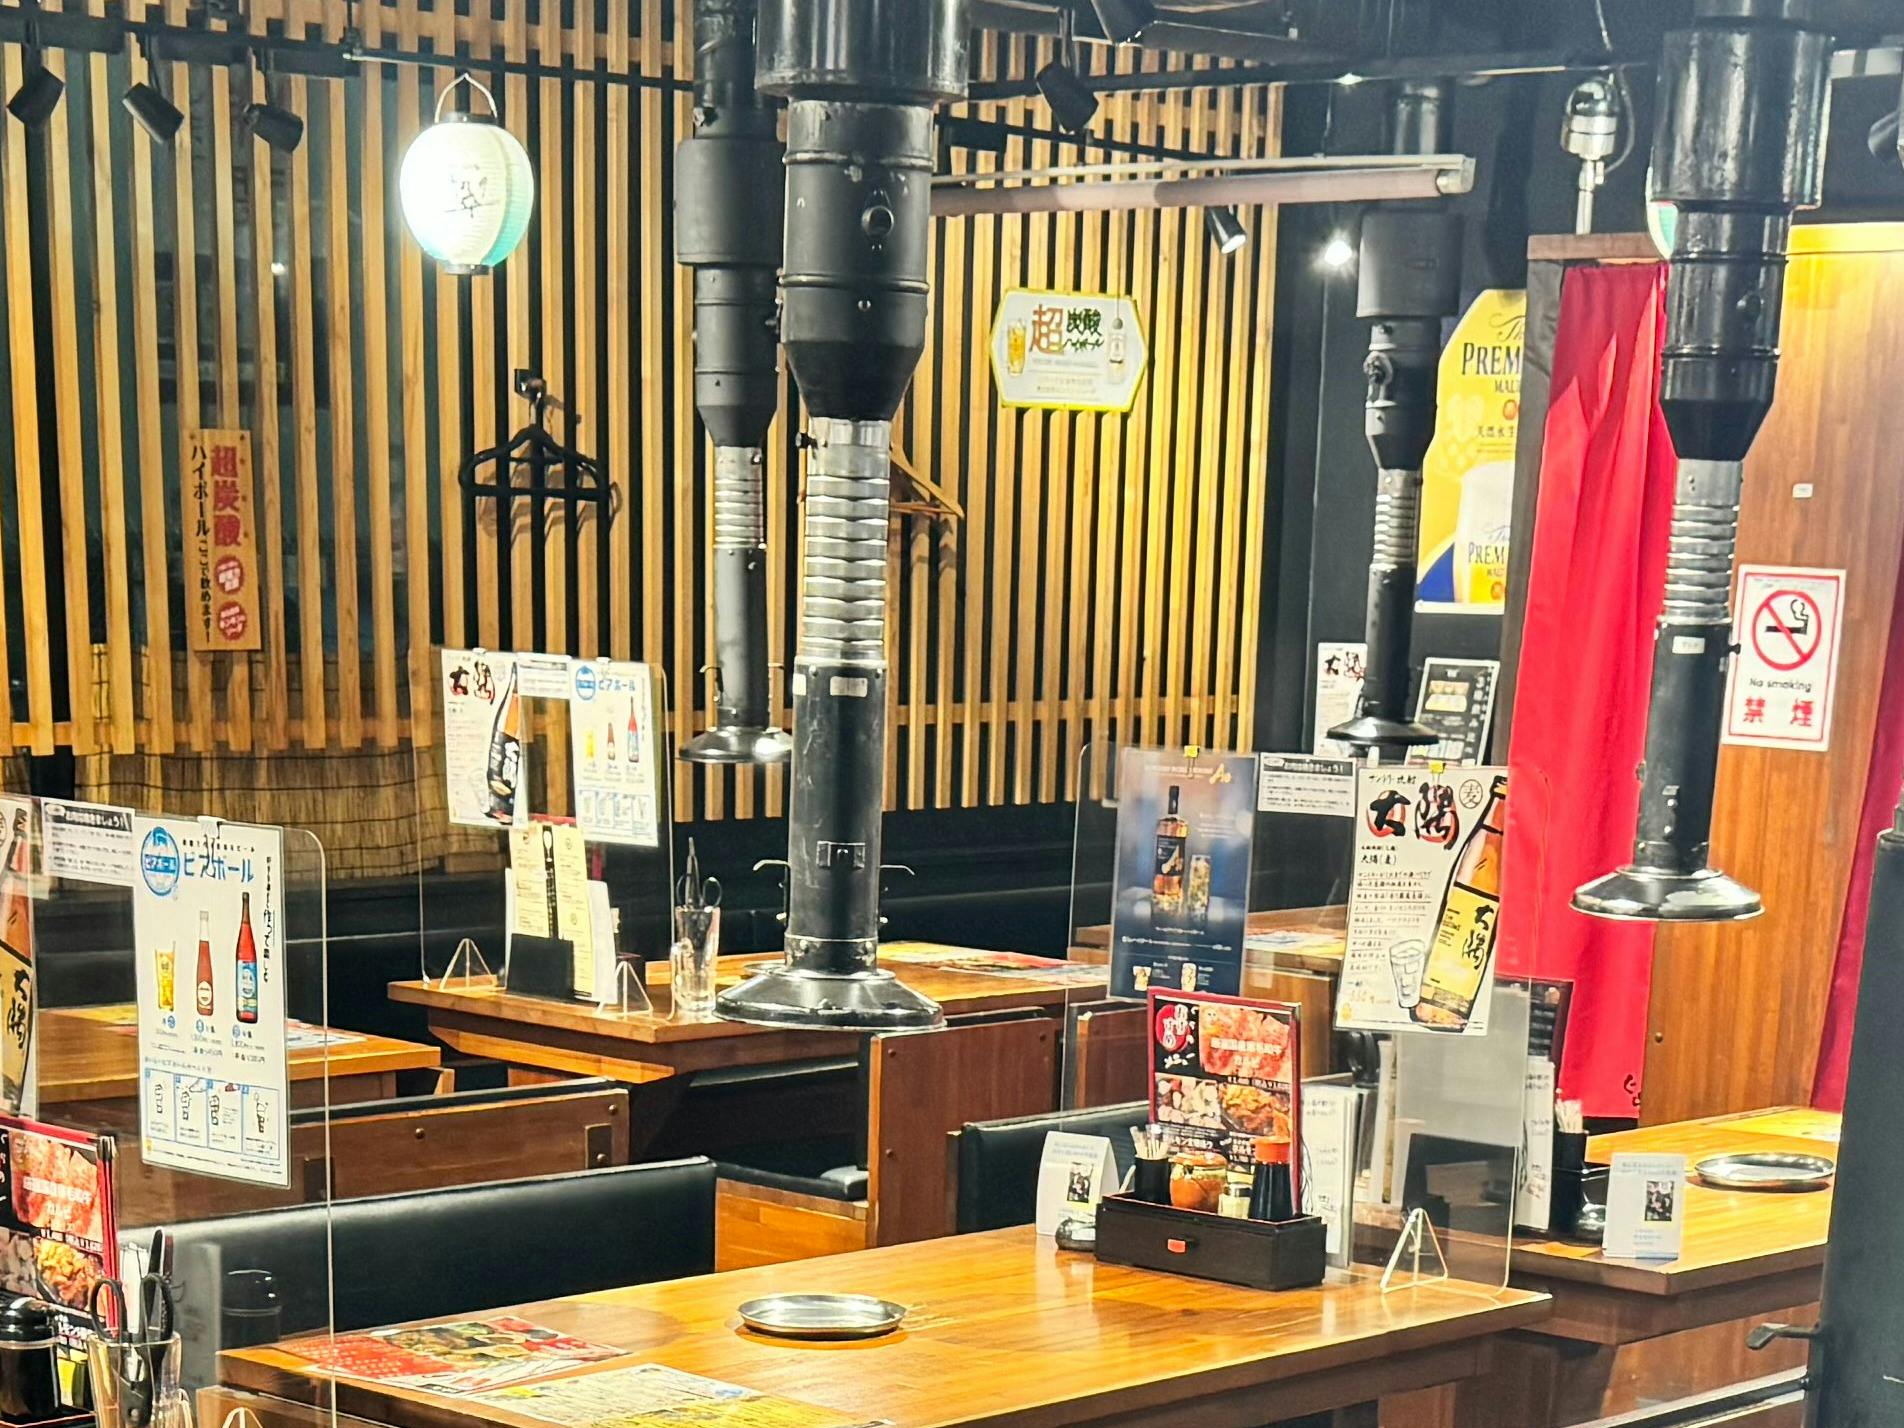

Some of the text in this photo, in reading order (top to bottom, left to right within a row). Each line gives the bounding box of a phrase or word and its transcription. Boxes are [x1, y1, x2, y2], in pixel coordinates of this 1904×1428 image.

[1029, 303, 1103, 356] 超 炭酸
[1748, 677, 1813, 693] No smoking
[1367, 773, 1418, 786] サントリー焼酎
[1366, 781, 1460, 851] 大隅
[1360, 853, 1397, 866] 大隅(麦)
